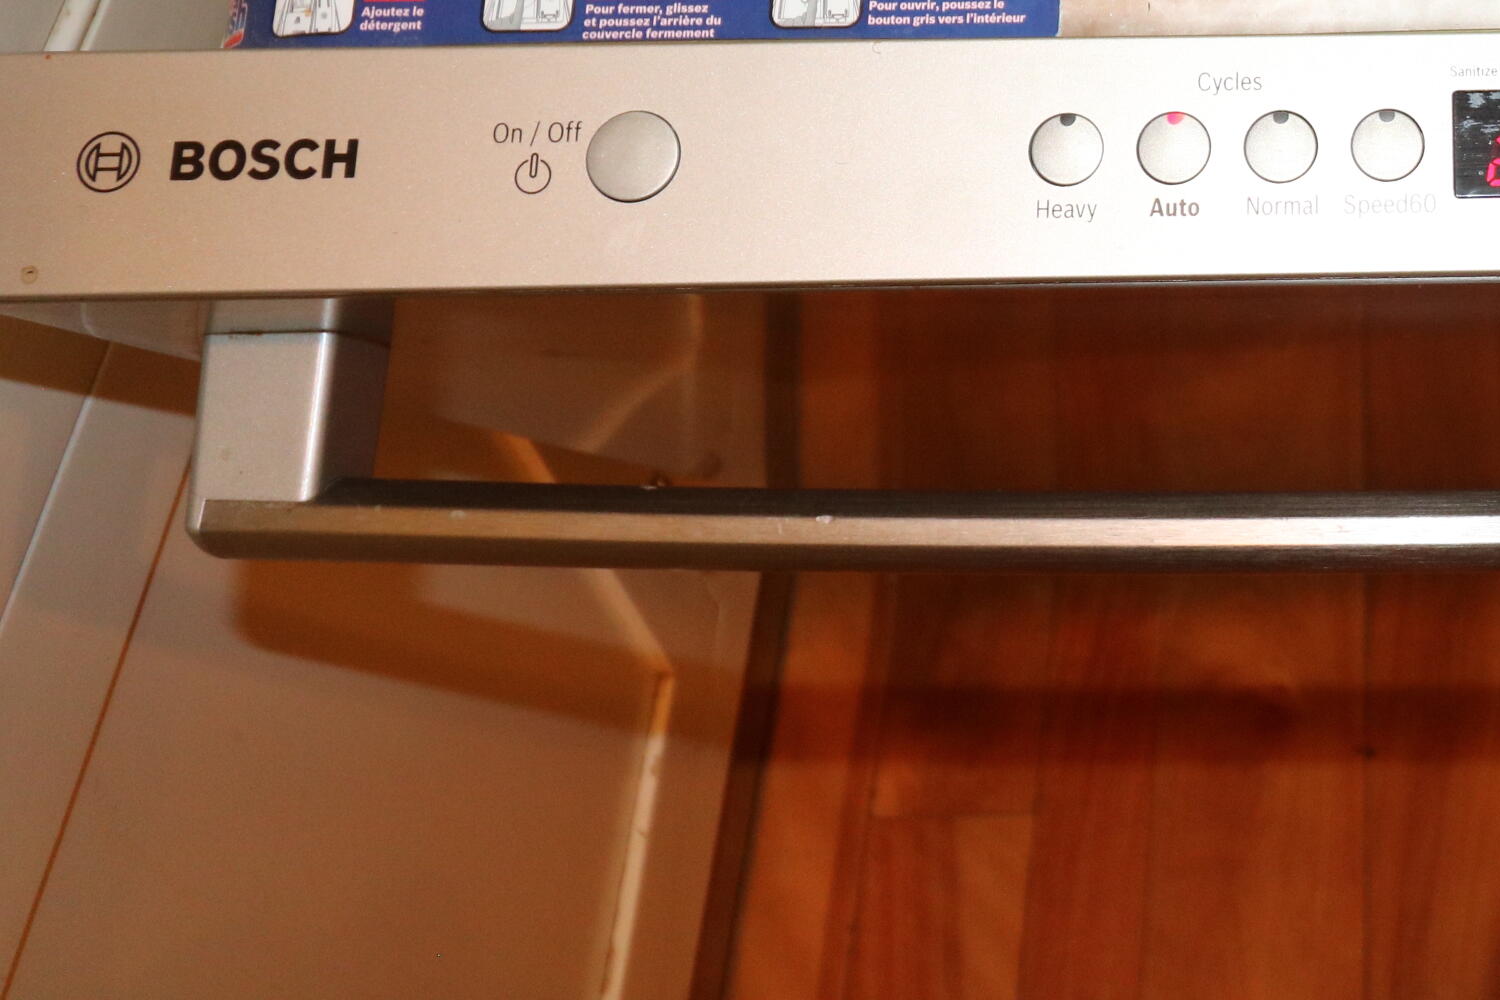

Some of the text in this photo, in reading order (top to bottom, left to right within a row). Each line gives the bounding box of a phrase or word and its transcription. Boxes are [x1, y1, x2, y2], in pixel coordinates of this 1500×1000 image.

[361, 6, 424, 19] Ajoutez le
[586, 3, 709, 16] Pour fermer, glissez
[868, 0, 897, 11] Pour
[900, 0, 940, 11] ouvrir,
[942, 0, 991, 11] poussez
[360, 20, 422, 32] détergent
[584, 15, 721, 29] et poussez l'arrière du
[867, 11, 1026, 26] bouton gris vers l'intérieur
[582, 27, 715, 40] couvercle fermement
[1450, 66, 1498, 77] Sanitize
[1198, 72, 1263, 96] Cycles
[493, 123, 524, 143] On
[547, 121, 583, 143] Off
[170, 139, 359, 181] BOSCH
[1036, 200, 1097, 223] Heavy
[1150, 198, 1199, 217] Auto
[1246, 195, 1319, 216] Normal
[1344, 194, 1436, 219] Speed60
